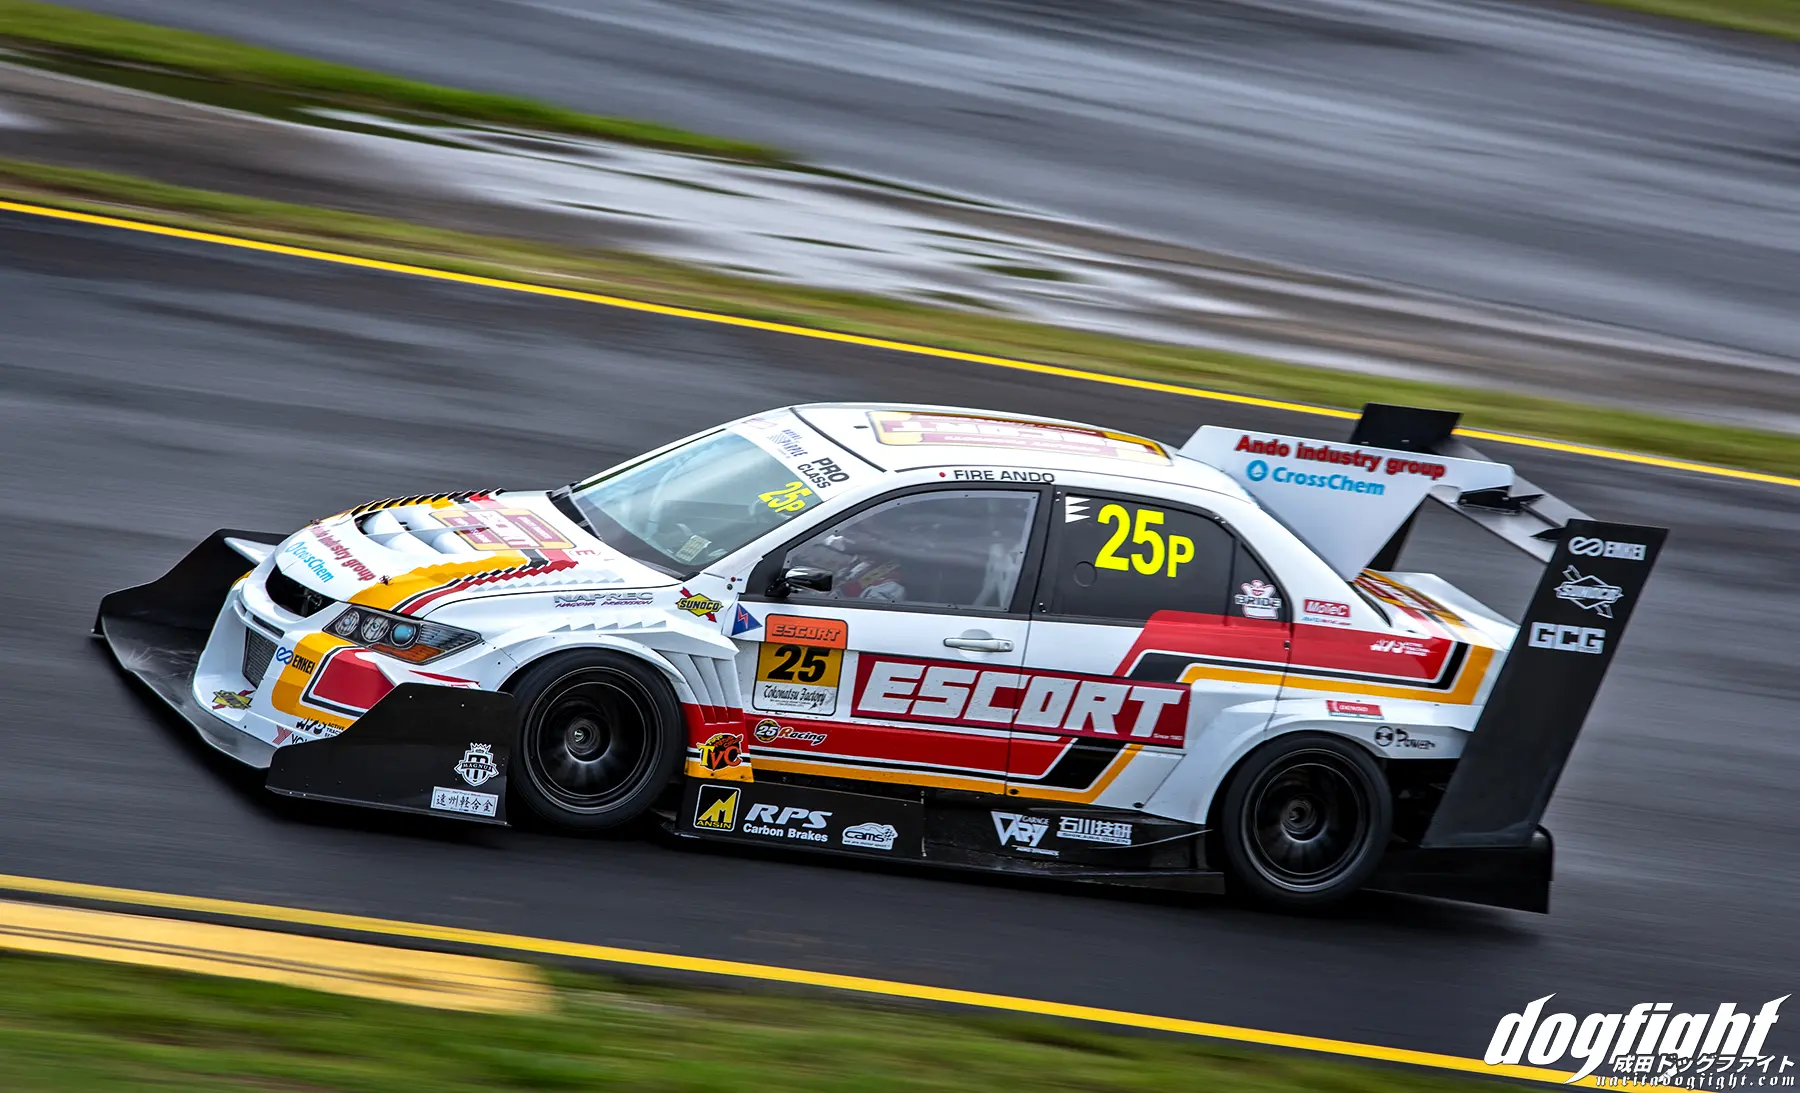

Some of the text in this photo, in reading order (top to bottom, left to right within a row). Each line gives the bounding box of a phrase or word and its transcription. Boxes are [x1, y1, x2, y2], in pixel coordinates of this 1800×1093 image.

[1234, 434, 1446, 480] Ando industry group
[797, 464, 831, 490] CLASS
[812, 457, 850, 483] PRO
[954, 470, 1055, 483] FIRE ANDO
[1272, 466, 1385, 496] CrossChem
[341, 558, 376, 581] group
[554, 592, 654, 603] NAPREC
[678, 600, 722, 611] SUNOCO
[1234, 594, 1282, 608] BRIDE
[1306, 600, 1348, 616] MoTeC
[771, 623, 841, 642] ESCORT
[1528, 622, 1606, 654] GCG
[292, 654, 316, 674] ENKEI
[766, 644, 830, 682] 25
[801, 688, 827, 705] Factory
[857, 660, 1186, 737] ESCORT
[756, 726, 827, 745] 25 Racing
[462, 762, 493, 772] MAGNUS
[696, 819, 732, 830] ANSIN
[744, 803, 833, 829] RPS
[1022, 816, 1050, 825] GARAGE
[742, 822, 828, 842] Carbon Brakes
[844, 830, 884, 842] cams
[1058, 816, 1132, 839] 石川技研
